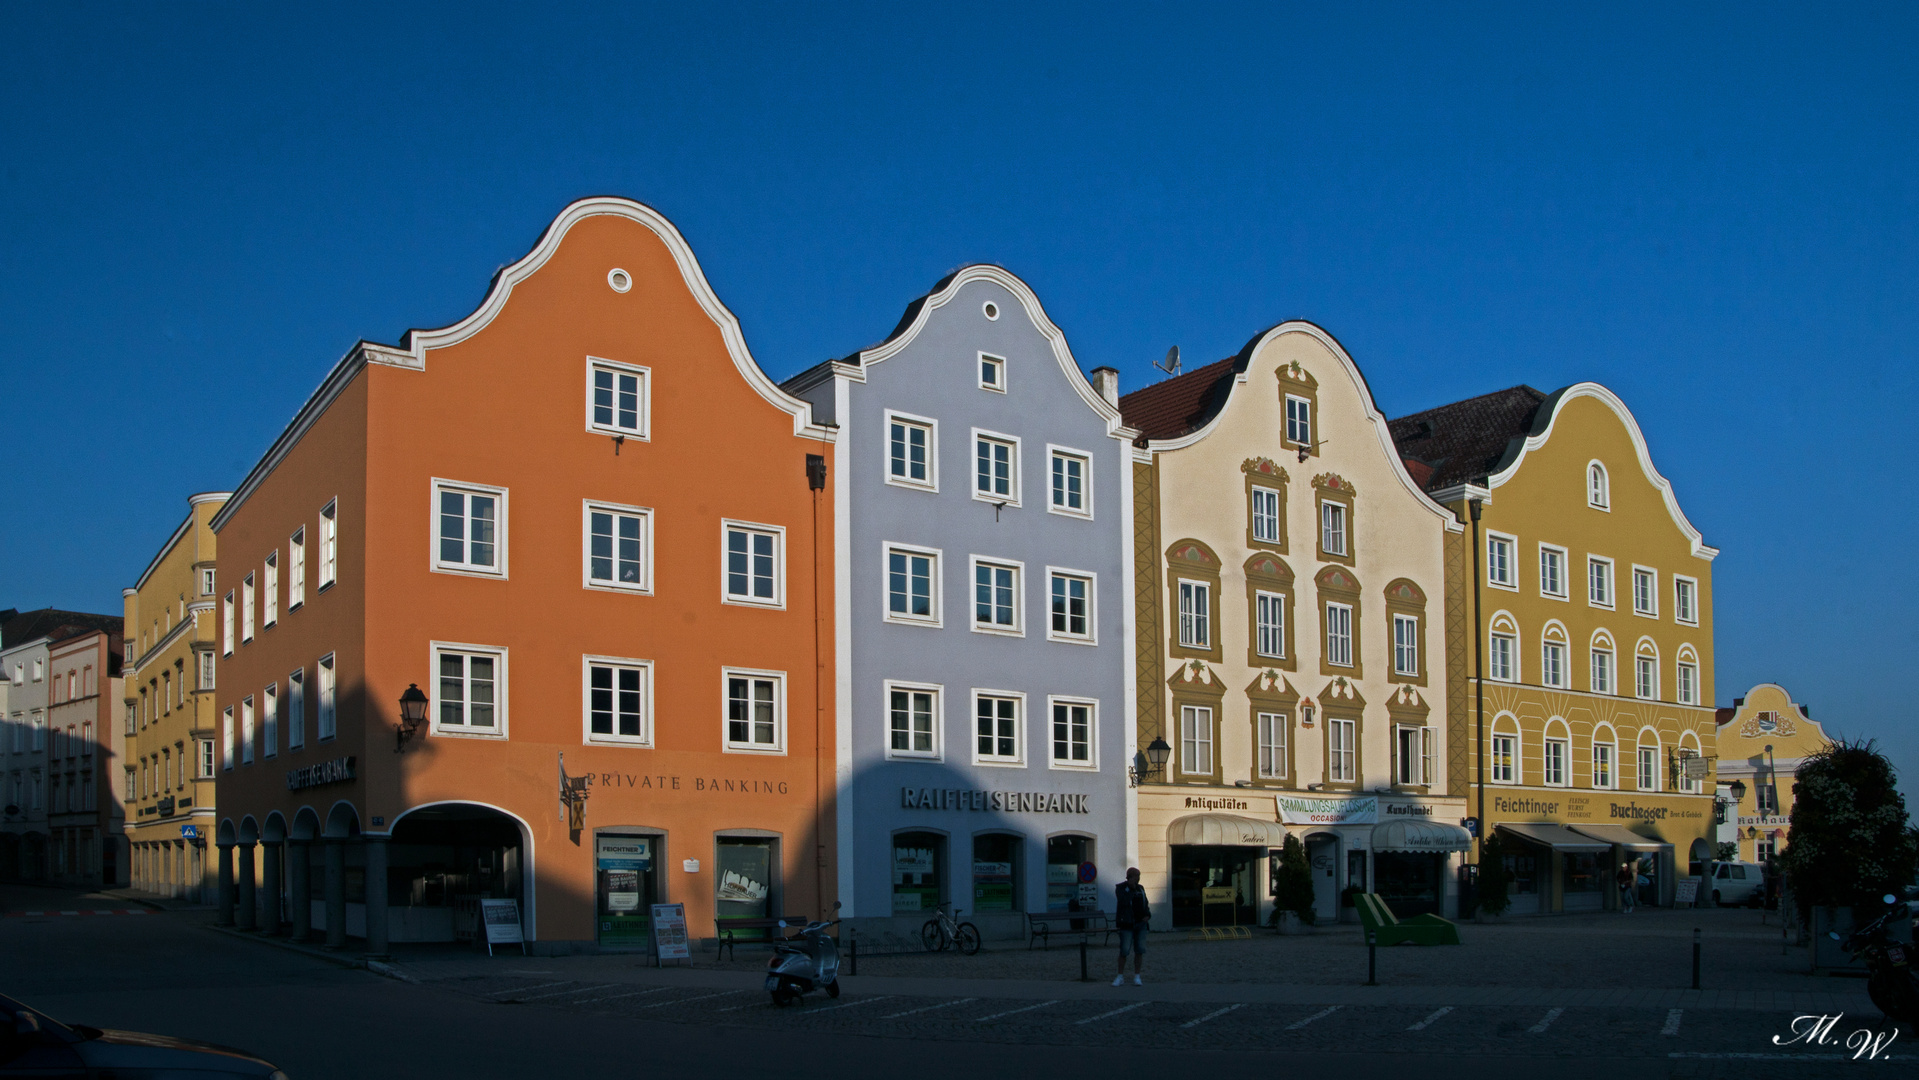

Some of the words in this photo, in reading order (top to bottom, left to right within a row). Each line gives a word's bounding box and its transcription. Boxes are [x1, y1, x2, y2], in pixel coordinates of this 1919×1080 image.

[587, 773, 680, 790] PRIVATE
[696, 777, 788, 795] BANKING
[902, 787, 1090, 814] RAIFFEISENBANK
[1185, 797, 1247, 811] Antiquitäten
[1386, 804, 1433, 816] Kunsthandel
[1494, 796, 1559, 817] Feichtinger
[1609, 801, 1668, 825] Buchegger
[1241, 833, 1265, 843] Galerie
